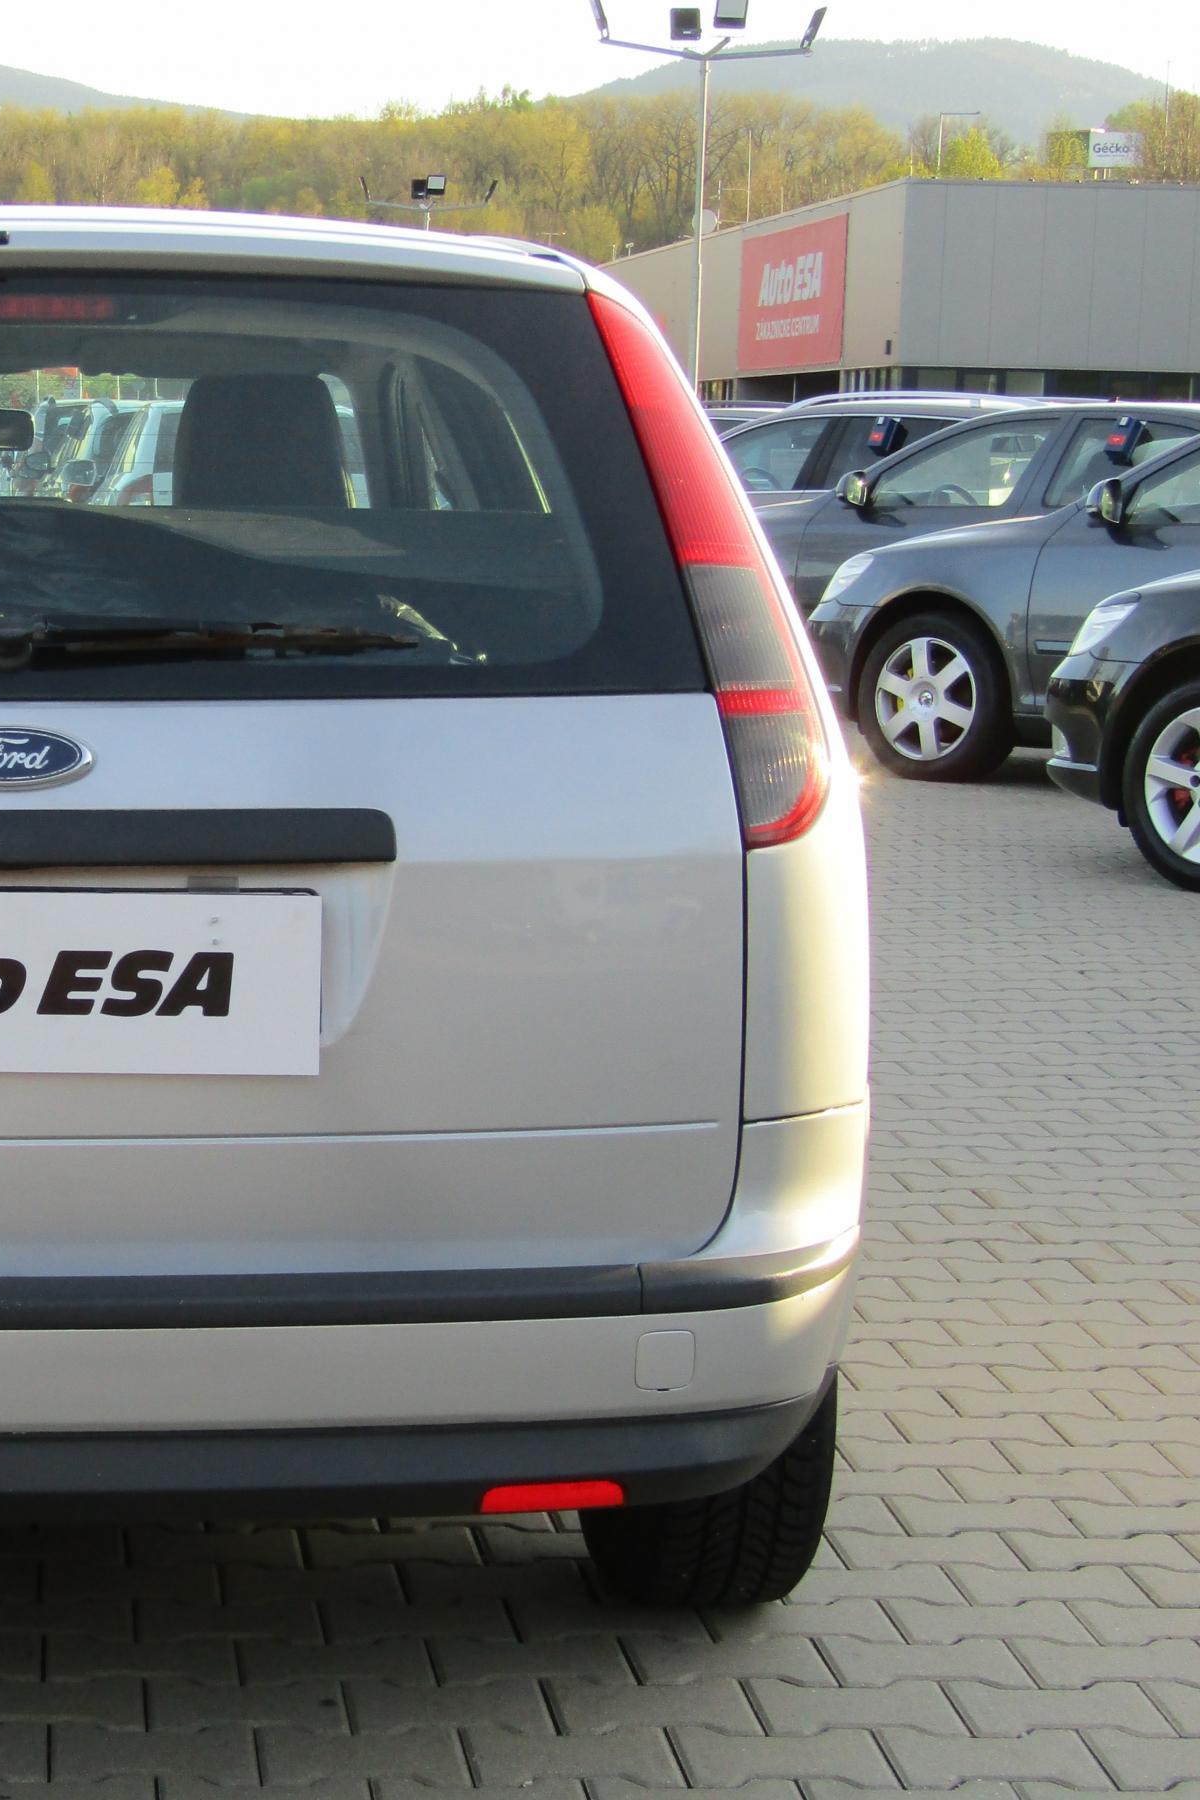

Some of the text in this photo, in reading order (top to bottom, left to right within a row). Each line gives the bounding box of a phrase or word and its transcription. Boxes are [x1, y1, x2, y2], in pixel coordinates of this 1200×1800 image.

[1093, 142, 1129, 153] Géčko
[758, 252, 822, 306] Auto ESA
[36, 949, 234, 1017] ESA
